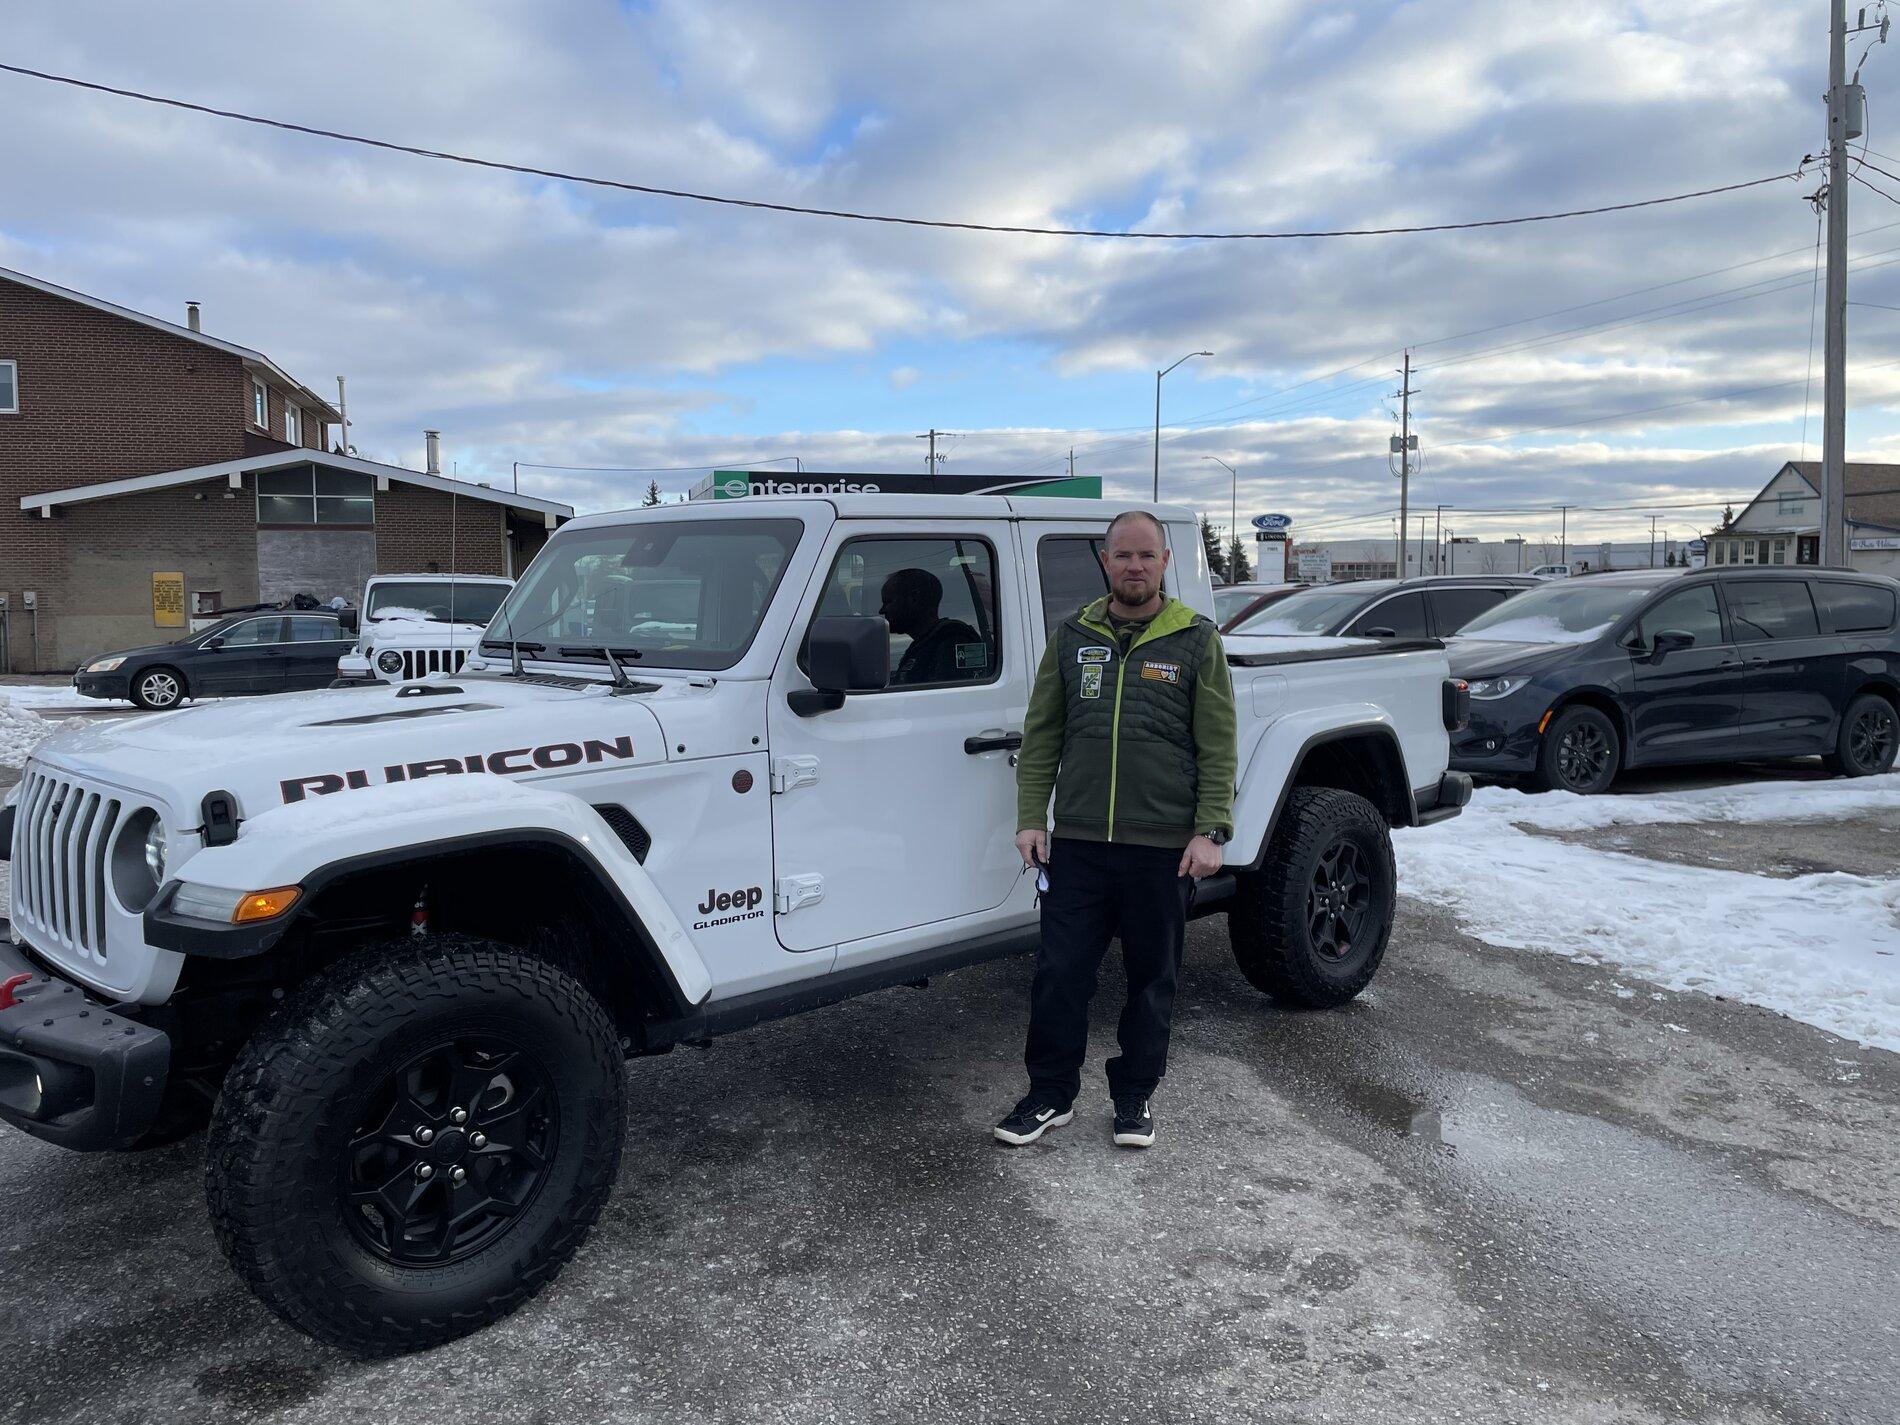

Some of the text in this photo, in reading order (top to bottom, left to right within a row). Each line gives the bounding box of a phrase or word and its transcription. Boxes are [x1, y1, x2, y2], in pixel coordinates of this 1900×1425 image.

[724, 478, 881, 497] enterprise
[1262, 515, 1286, 527] Ford
[1264, 532, 1286, 540] LINCOLN
[279, 736, 635, 805] RUBICON
[698, 886, 762, 915] Jeep
[693, 910, 765, 930] GLADIATOR
